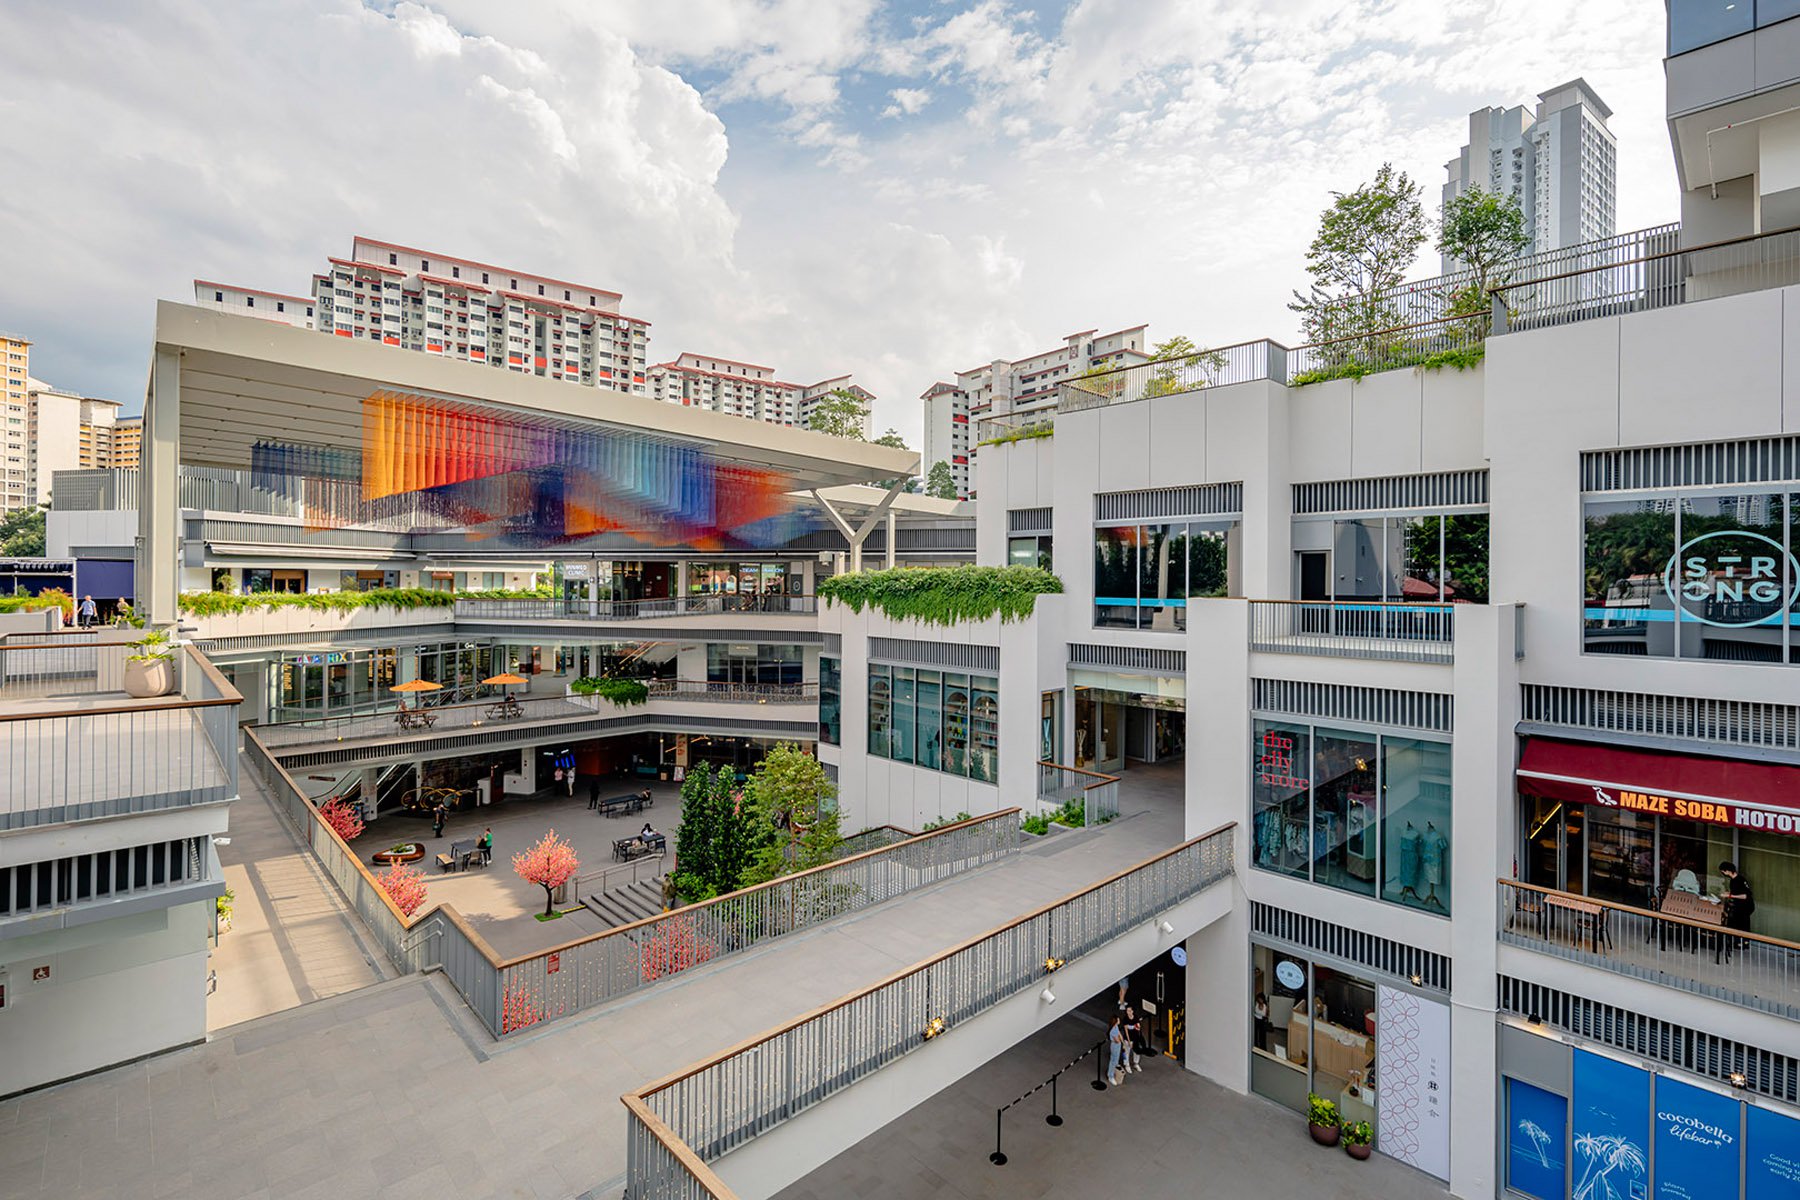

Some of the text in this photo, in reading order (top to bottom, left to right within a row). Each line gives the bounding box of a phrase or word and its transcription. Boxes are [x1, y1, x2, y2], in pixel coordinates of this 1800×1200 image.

[1263, 731, 1293, 750] the
[1261, 751, 1294, 774] elly
[1262, 773, 1309, 791] store
[1620, 791, 1669, 814] MAZE
[1675, 799, 1729, 822] SOBA
[1657, 1111, 1736, 1144] cocobella
[1669, 1124, 1713, 1146] lifebar
[1762, 1159, 1793, 1173] coming
[1769, 1153, 1790, 1165] Good
[1770, 1168, 1790, 1179] early
